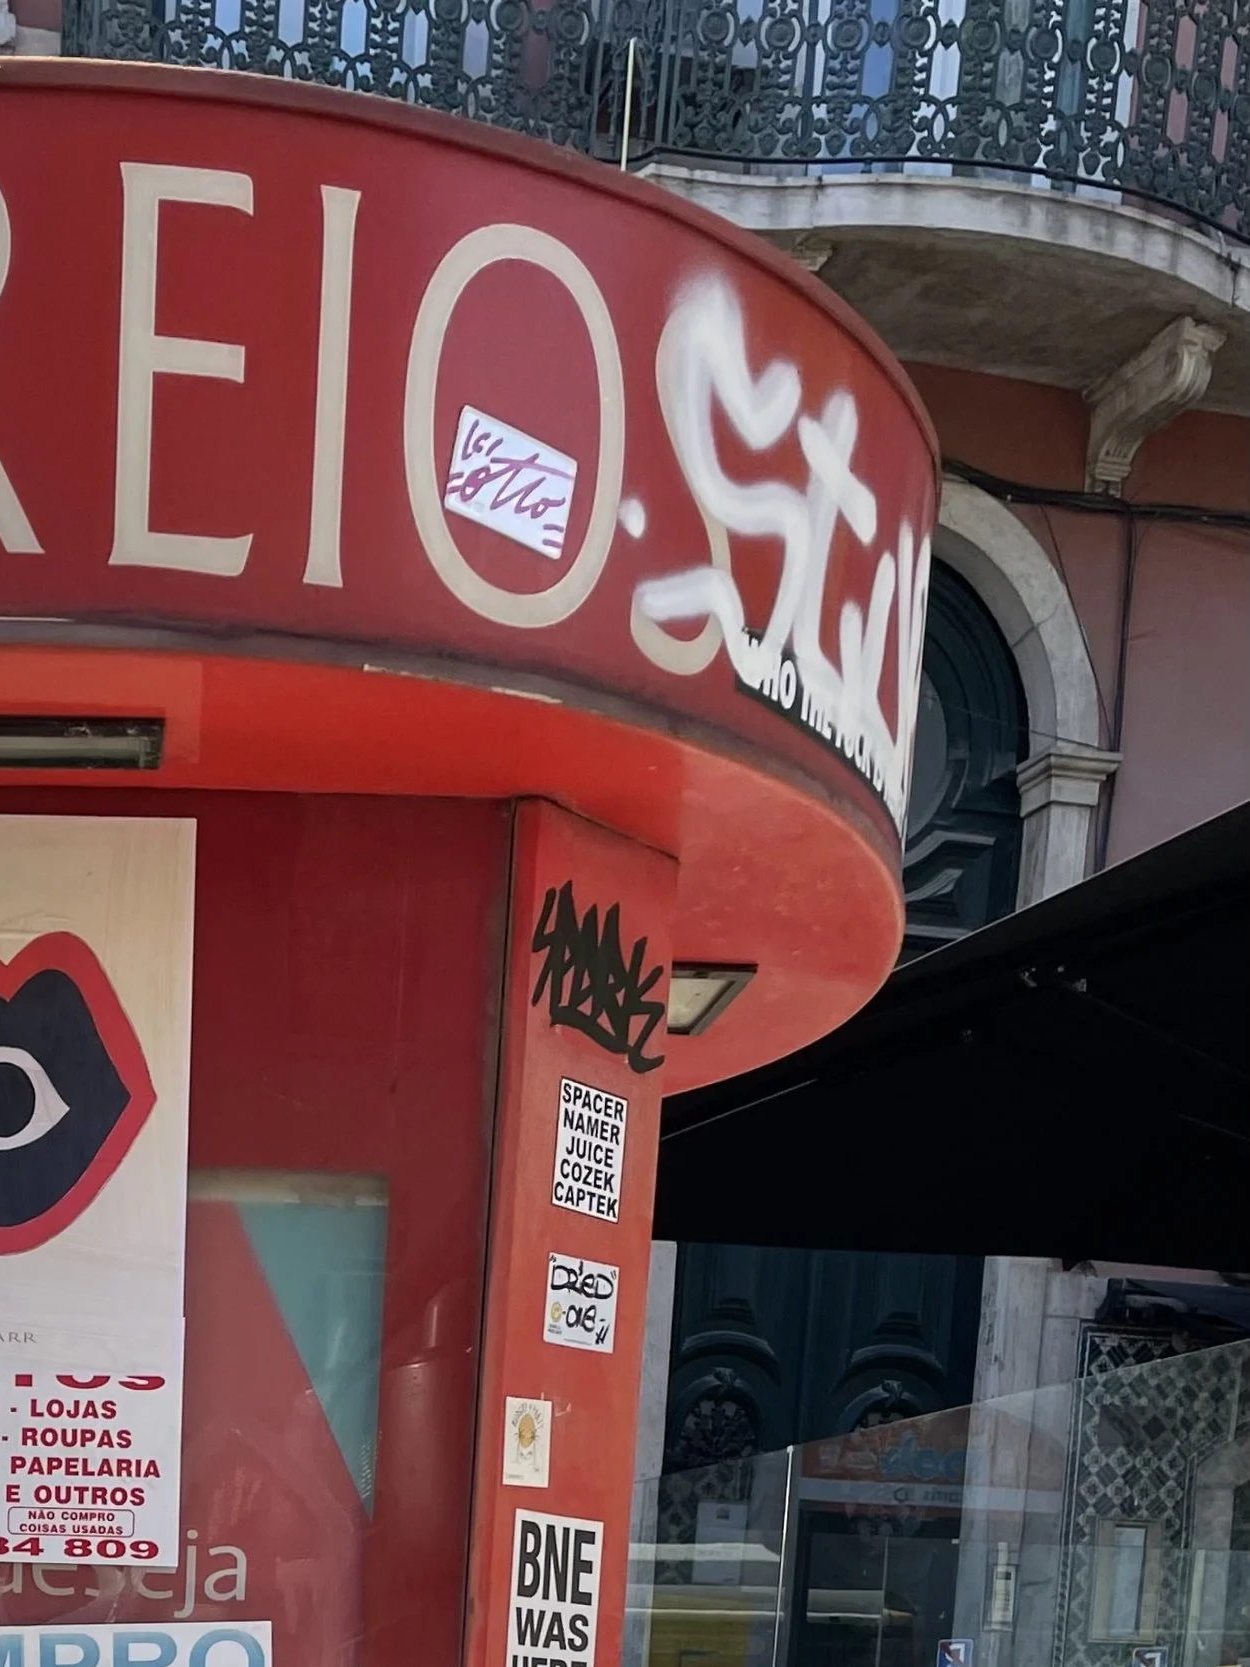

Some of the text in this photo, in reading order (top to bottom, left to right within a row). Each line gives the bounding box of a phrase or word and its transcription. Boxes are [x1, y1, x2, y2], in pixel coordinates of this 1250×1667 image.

[563, 1083, 624, 1122] SPACER
[563, 1108, 620, 1146] NAMER
[566, 1136, 614, 1169] JUICE
[560, 1158, 615, 1194] COZEK
[554, 1181, 618, 1219] CAPTEK
[30, 1399, 118, 1420] LOJAS
[21, 1428, 133, 1449] ROUPAS
[10, 1456, 161, 1478] PAPELARIA
[6, 1485, 22, 1502] E
[34, 1485, 146, 1506] OUTROS
[19, 1523, 124, 1536] COISAS USADAS
[28, 1509, 116, 1523] NÃO COMPRO
[62, 1538, 160, 1560] 809
[517, 1518, 597, 1606] BNE
[515, 1606, 590, 1653] WAS
